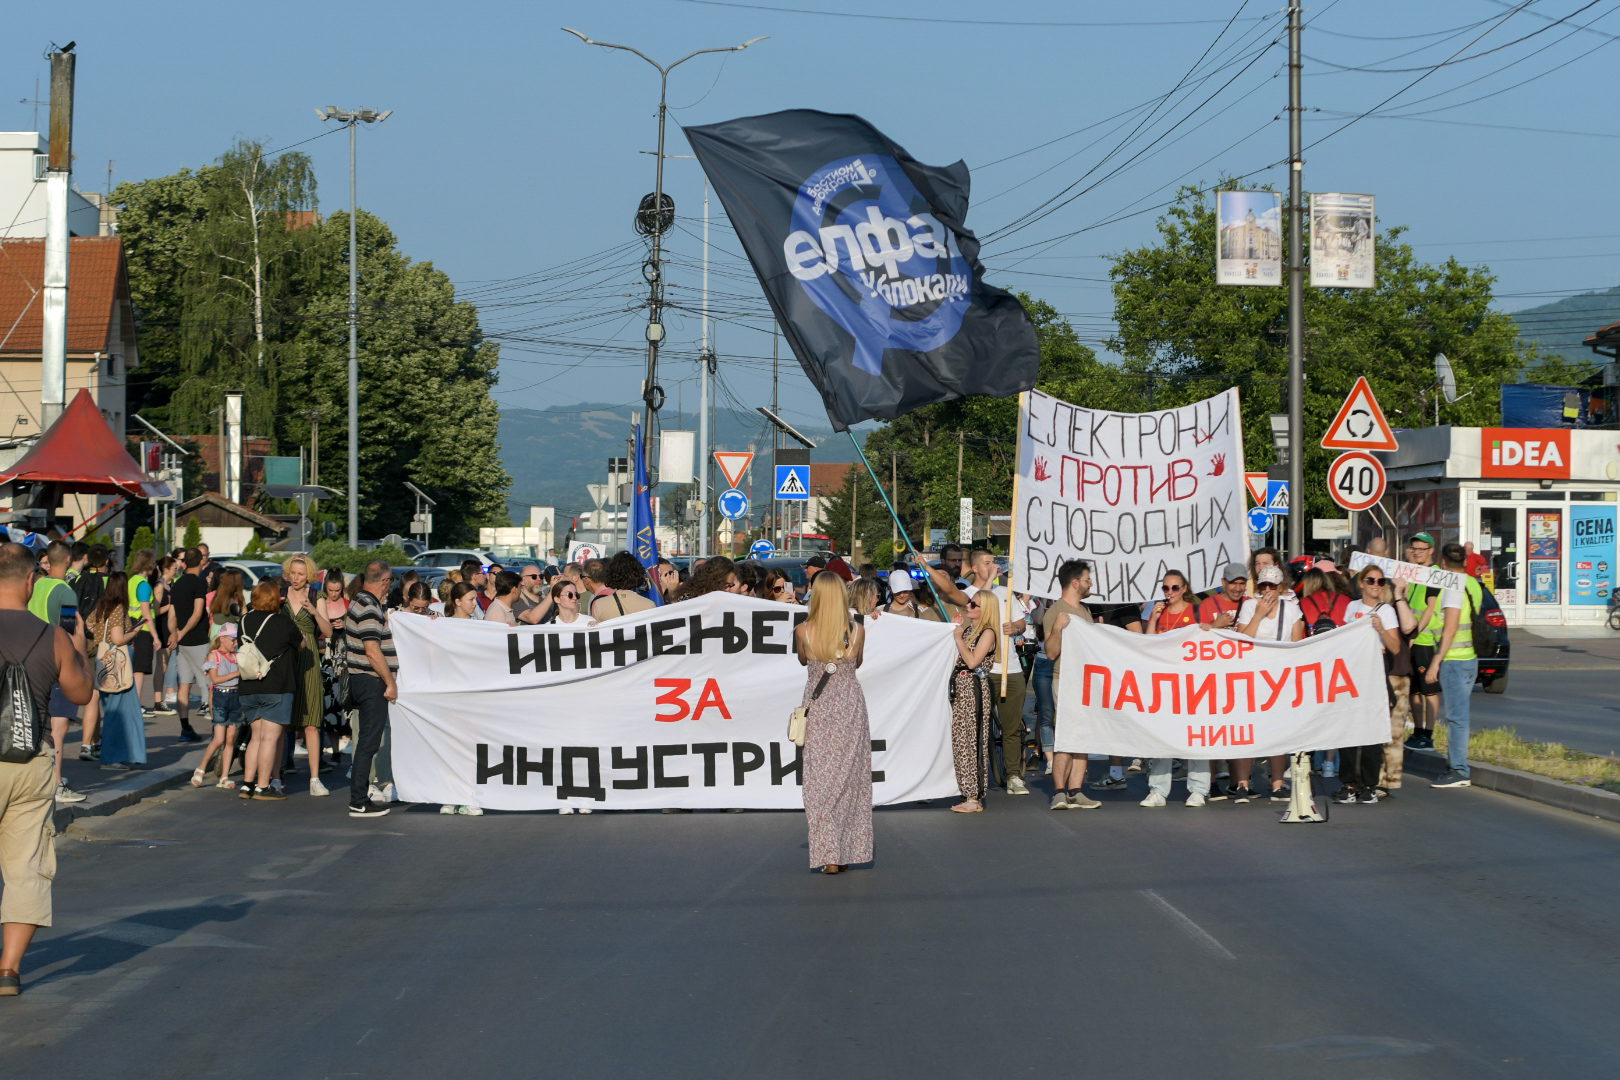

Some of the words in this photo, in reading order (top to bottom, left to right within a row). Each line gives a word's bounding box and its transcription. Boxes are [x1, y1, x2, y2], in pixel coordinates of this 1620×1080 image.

[1027, 389, 1230, 459] ЕЛЕКТРОНИ
[1060, 454, 1199, 506] ПРОТИВ
[1338, 466, 1374, 496] 40
[1026, 490, 1233, 555] СЛОБОДНИХ
[1576, 518, 1614, 536] CENA
[1580, 535, 1615, 546] KVALITET
[507, 610, 864, 675] ИНЖЕЊЕ
[1181, 639, 1255, 662] ЗБОР
[654, 678, 732, 723] ЗА
[1082, 658, 1360, 715] ПАЛИЛУЛА
[1187, 723, 1255, 747] НИШ
[476, 739, 887, 802] ИНДУСТРИ
